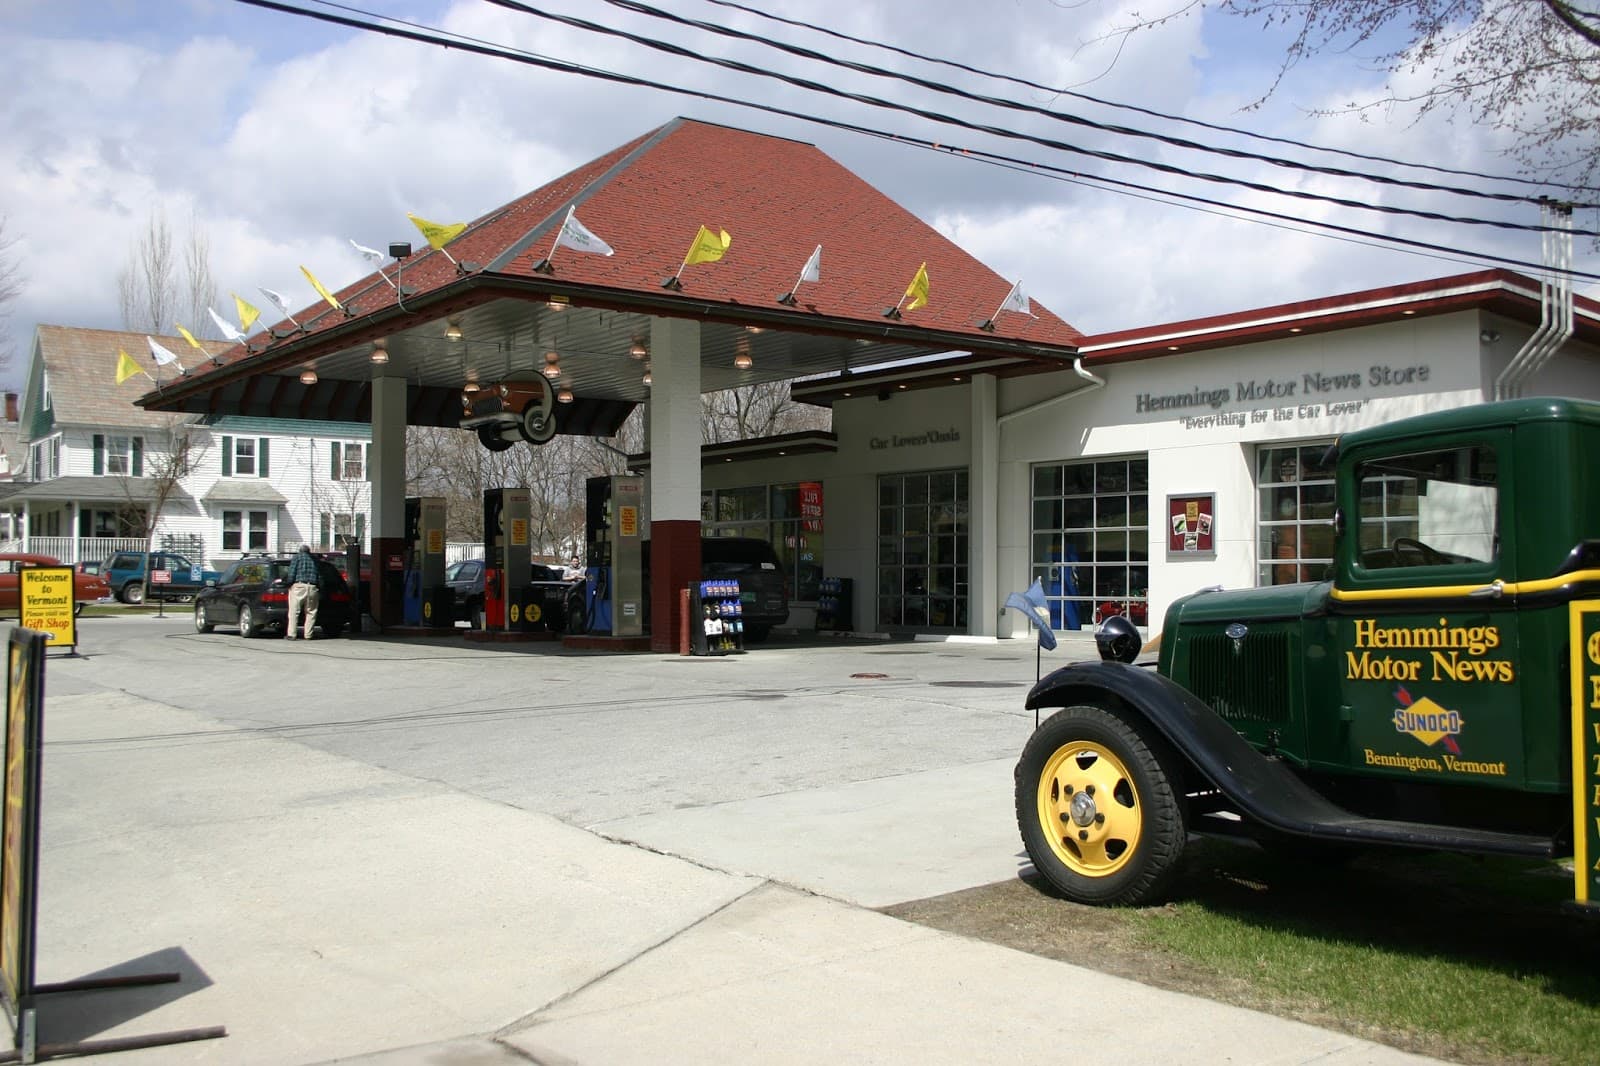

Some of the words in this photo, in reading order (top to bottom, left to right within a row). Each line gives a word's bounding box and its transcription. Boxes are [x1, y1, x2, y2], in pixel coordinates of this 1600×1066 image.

[1135, 385, 1230, 413] Hemmings
[1236, 379, 1297, 402] Motor
[1302, 372, 1361, 395] News
[1369, 365, 1430, 388] Store
[1251, 408, 1268, 424] for
[1273, 406, 1294, 421] the
[1298, 404, 1320, 420] Car
[869, 437, 888, 450] Car
[26, 572, 69, 583] Welcome
[42, 585, 52, 593] to
[27, 595, 67, 605] Vermont
[25, 618, 44, 630] Gift
[47, 618, 70, 629] Shop
[1353, 617, 1500, 655] Hemmings
[1345, 651, 1422, 681] Motor
[1430, 651, 1515, 682] News
[1395, 709, 1460, 734] SUNOCO
[1364, 749, 1442, 772] Bennington,
[1443, 755, 1507, 775] Vermont
